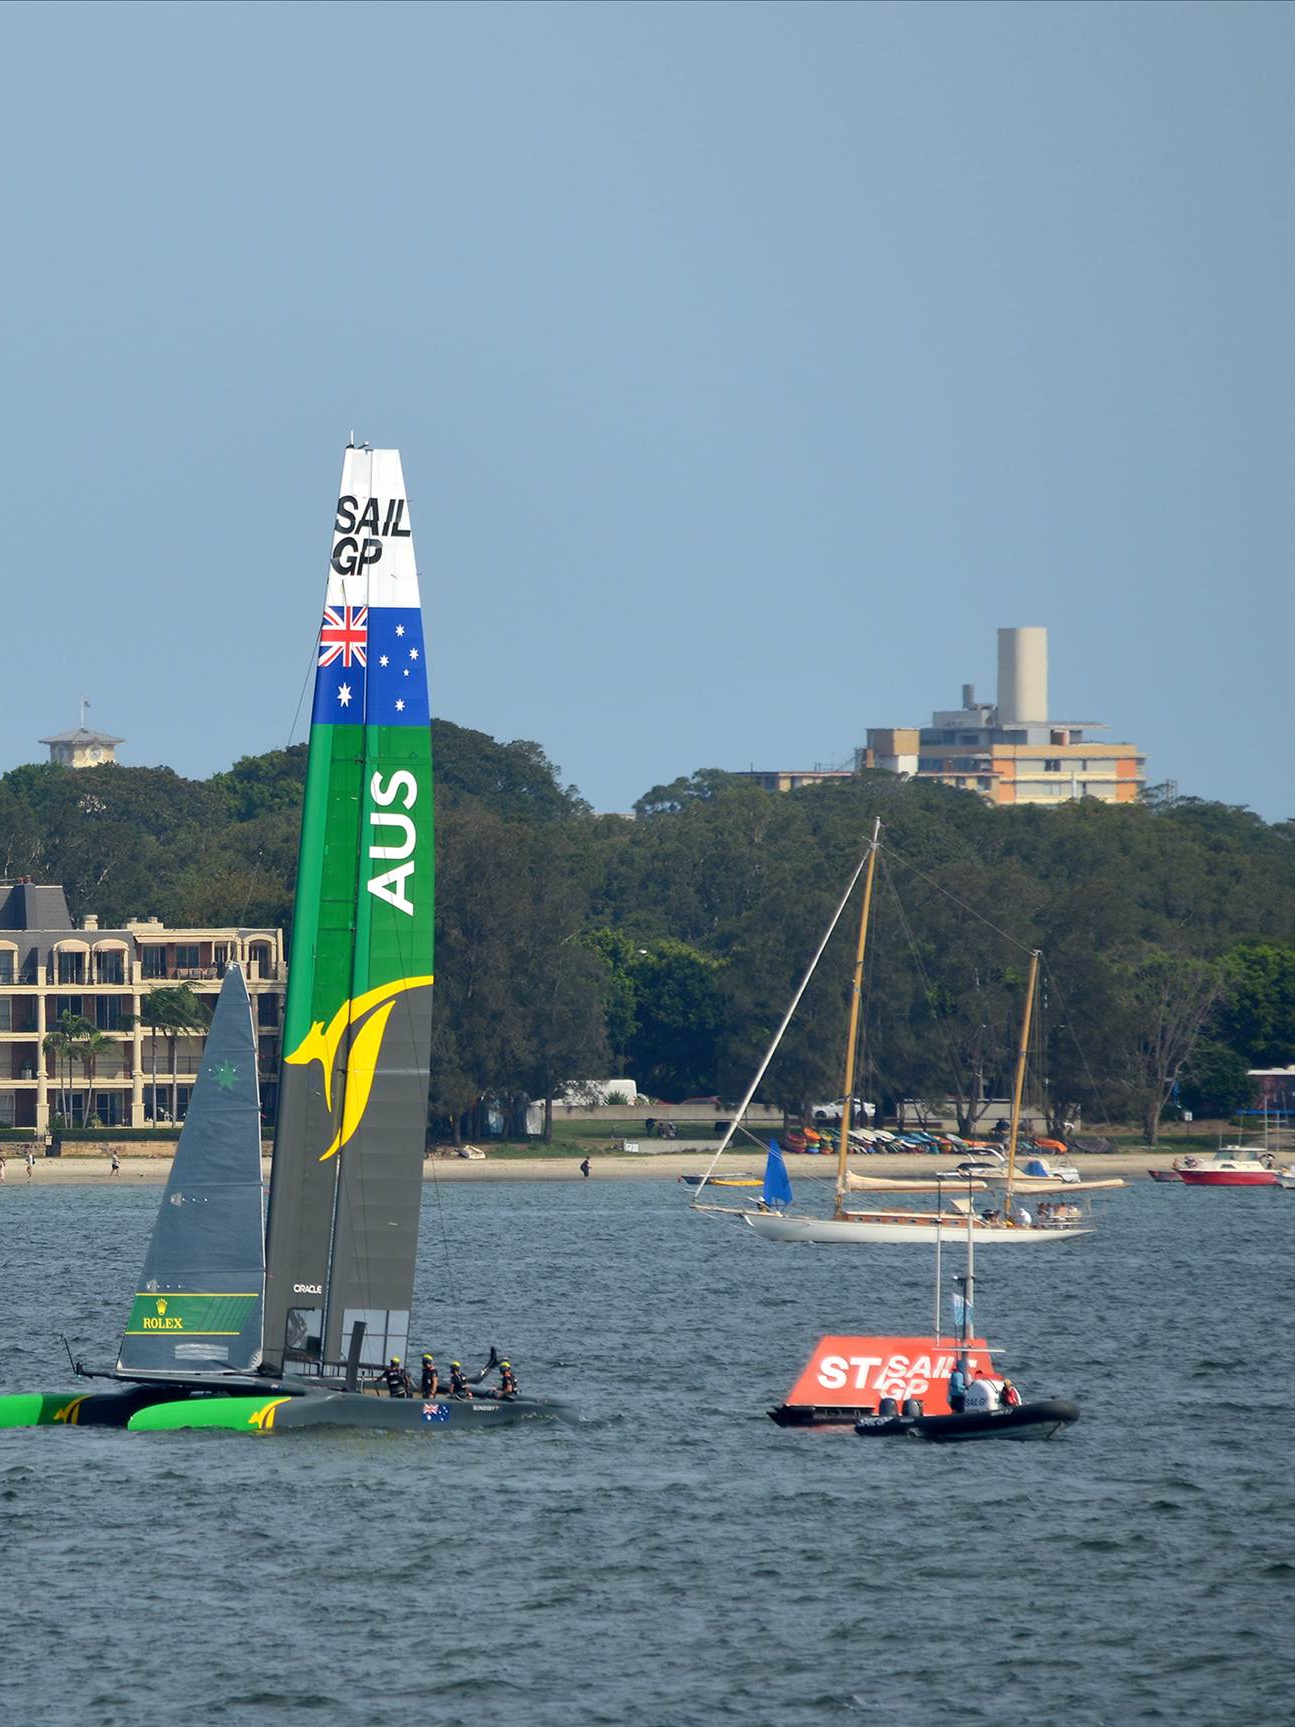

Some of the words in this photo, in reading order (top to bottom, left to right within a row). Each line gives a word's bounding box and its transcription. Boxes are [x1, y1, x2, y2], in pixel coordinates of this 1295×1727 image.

[334, 495, 411, 537] SAIL
[330, 536, 383, 576] GP
[367, 769, 418, 916] AUS
[293, 1284, 322, 1294] ORACLE
[143, 1317, 183, 1329] ROLEX
[887, 1355, 955, 1379] SAIL
[880, 1378, 929, 1400] GP
